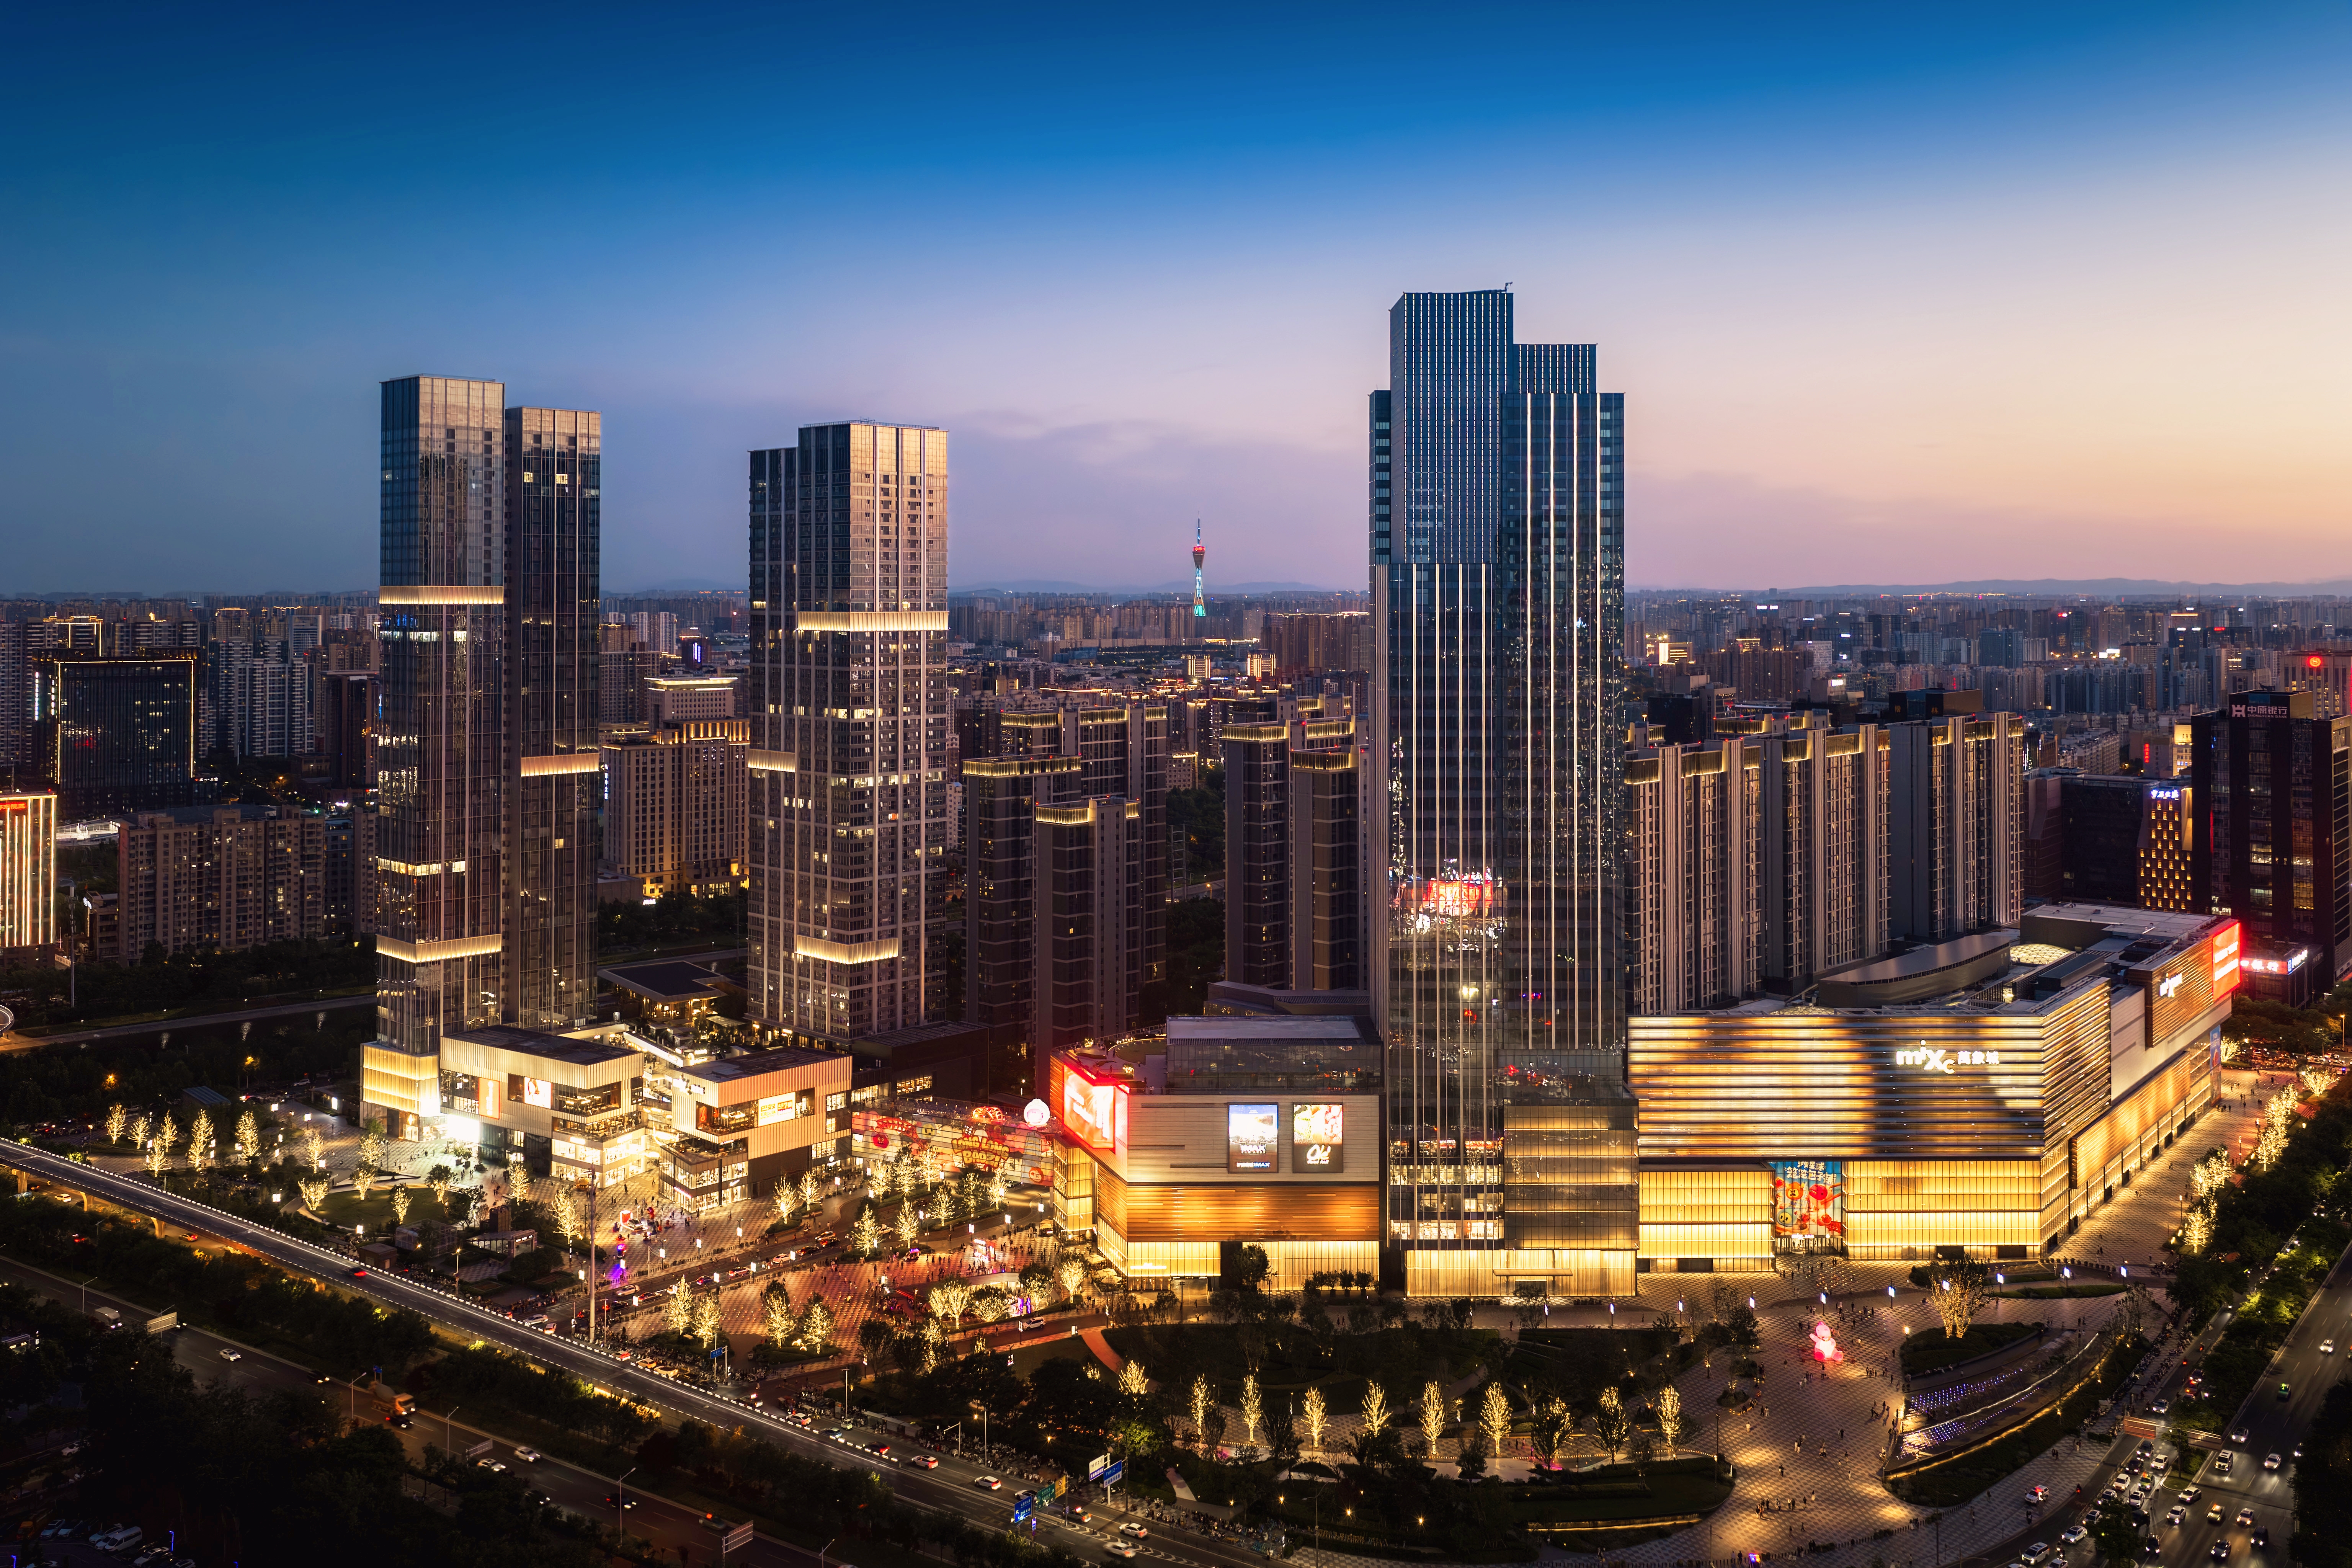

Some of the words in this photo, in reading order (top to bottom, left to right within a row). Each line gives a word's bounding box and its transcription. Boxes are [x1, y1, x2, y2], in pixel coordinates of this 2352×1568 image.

[2247, 706, 2287, 715] 中原银行
[761, 1104, 775, 1112] 巴奴
[951, 1136, 980, 1154] LONG
[981, 1137, 1010, 1161] LONG
[962, 1150, 1000, 1167] BAOZI
